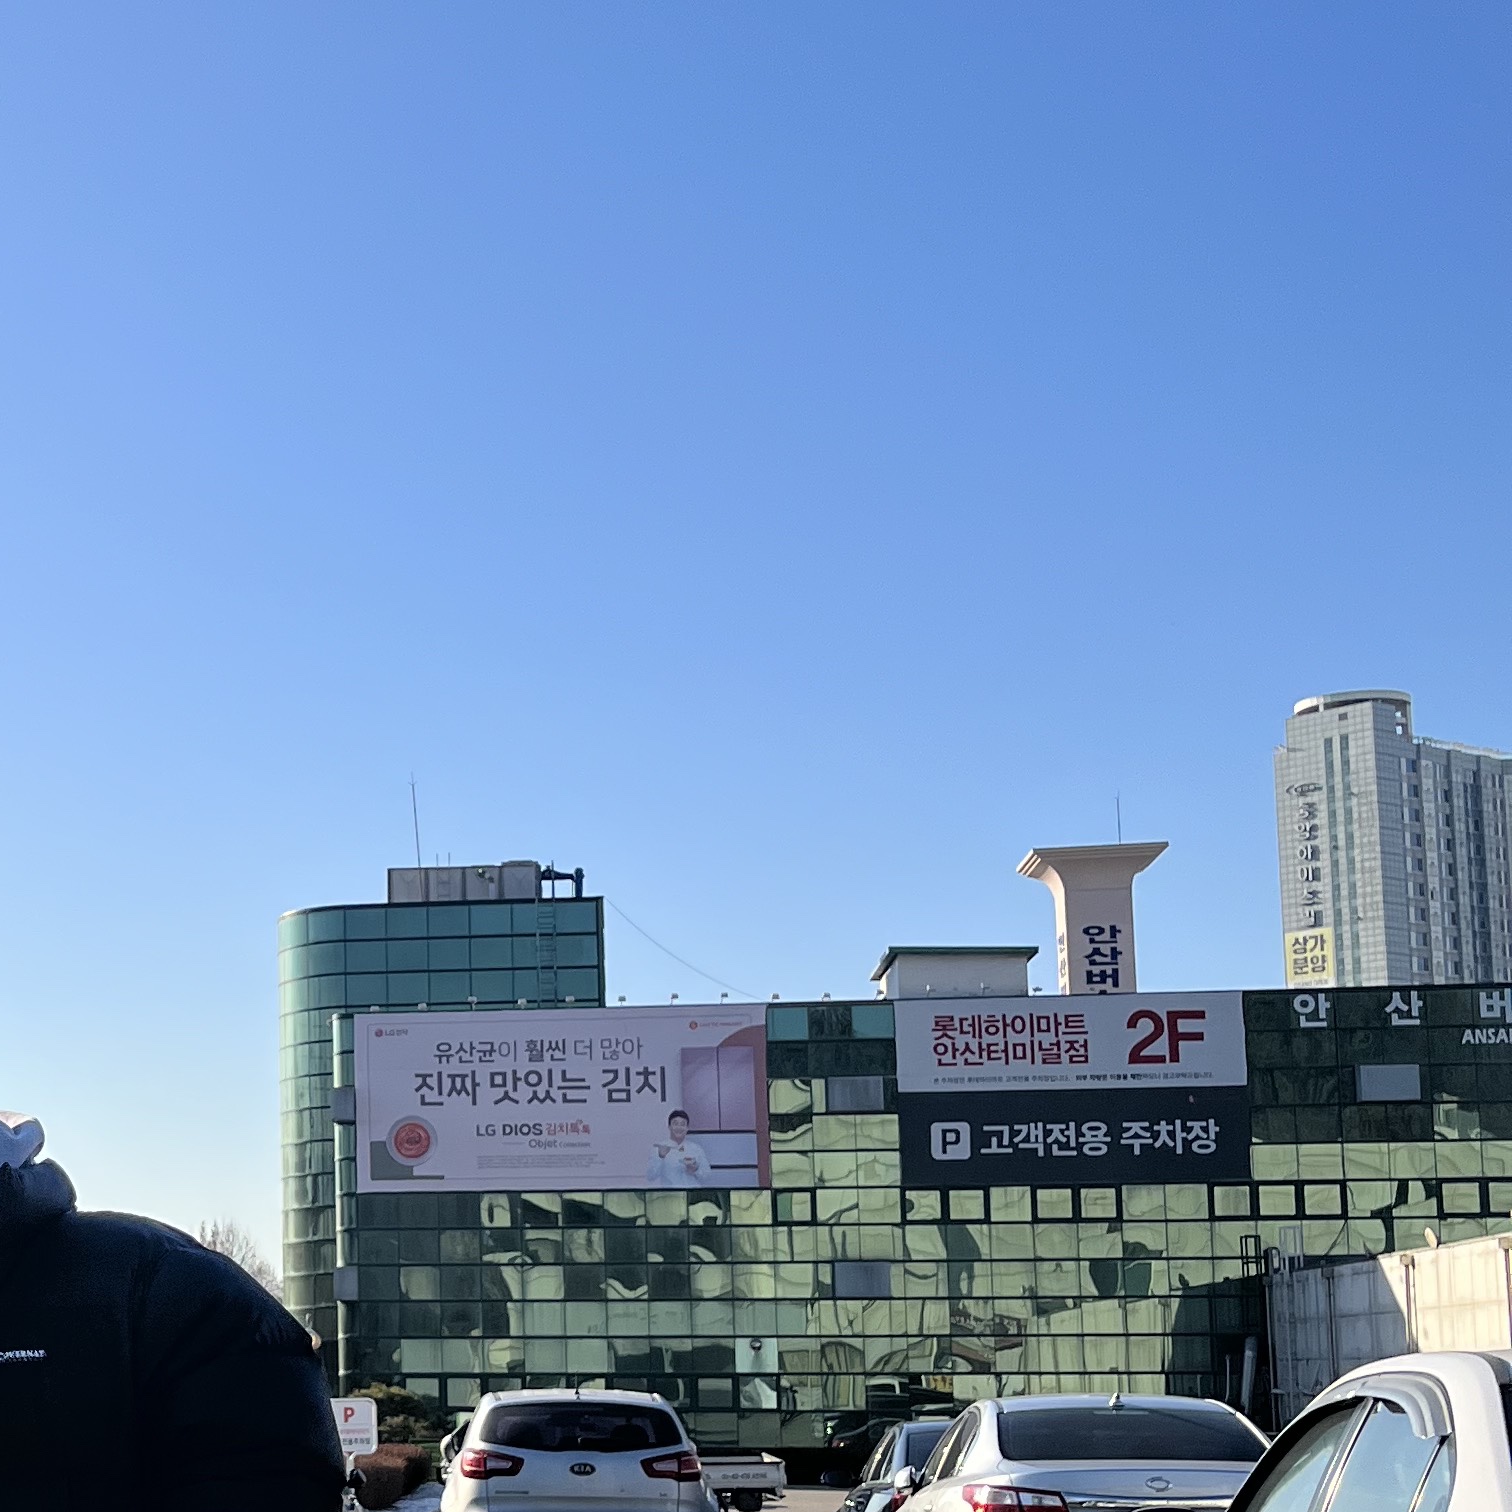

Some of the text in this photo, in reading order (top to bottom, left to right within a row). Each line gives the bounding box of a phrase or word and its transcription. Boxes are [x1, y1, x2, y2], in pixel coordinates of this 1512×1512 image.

[1292, 934, 1326, 955] 상가
[1082, 925, 1122, 995] 안산버
[931, 1012, 1088, 1041] 롯데하이마트
[1125, 1008, 1207, 1065] 2F
[434, 1036, 644, 1064] 유산균이 훨씬 더 많아
[932, 1038, 1089, 1067] 안산터미널점
[414, 1065, 667, 1106] 진짜 맛있는 김치
[476, 1123, 496, 1137] LG
[502, 1122, 543, 1137] DIOS
[980, 1120, 1112, 1158] 고객전용
[1120, 1117, 1220, 1156] 주차장
[528, 1138, 558, 1150] Objet
[344, 1406, 355, 1423] P
[573, 1465, 592, 1473] KIA
